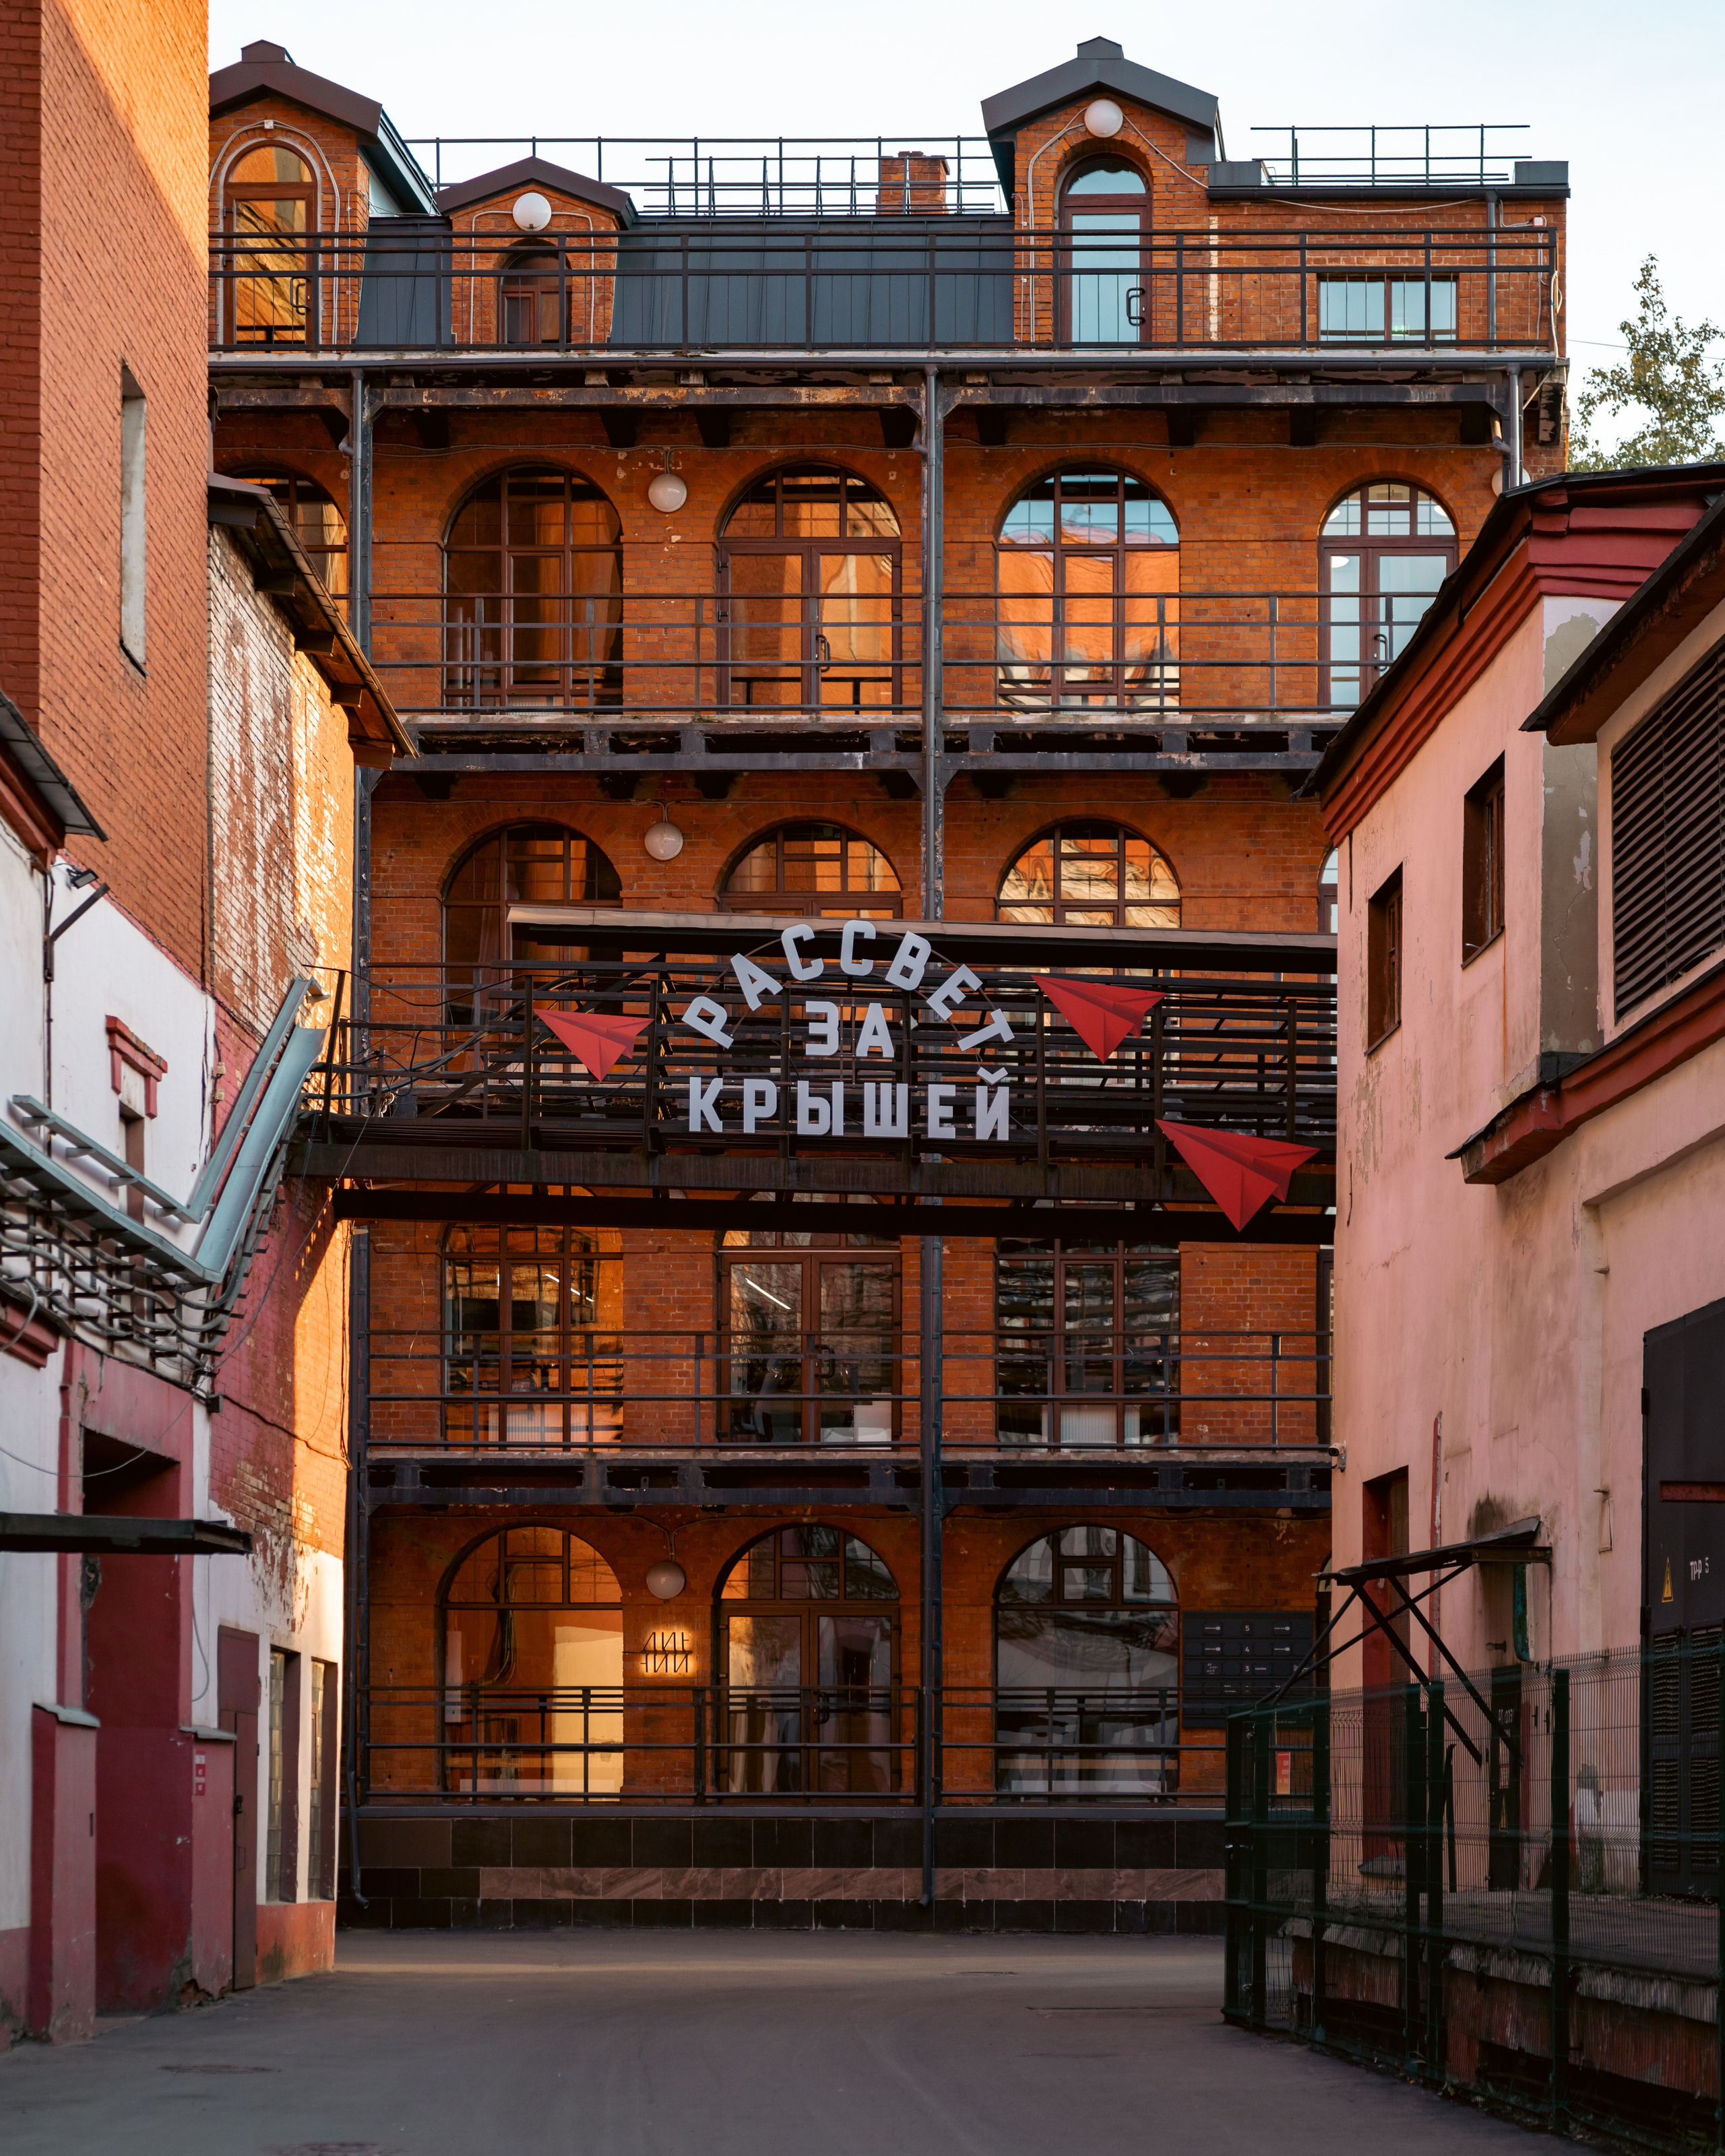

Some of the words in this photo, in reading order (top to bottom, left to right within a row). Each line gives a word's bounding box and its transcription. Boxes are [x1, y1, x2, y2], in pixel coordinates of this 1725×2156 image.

[681, 920, 1015, 1052] РАССВЕТ
[805, 1001, 895, 1058] ЗА
[689, 1067, 1010, 1141] КРЫШЕЙ
